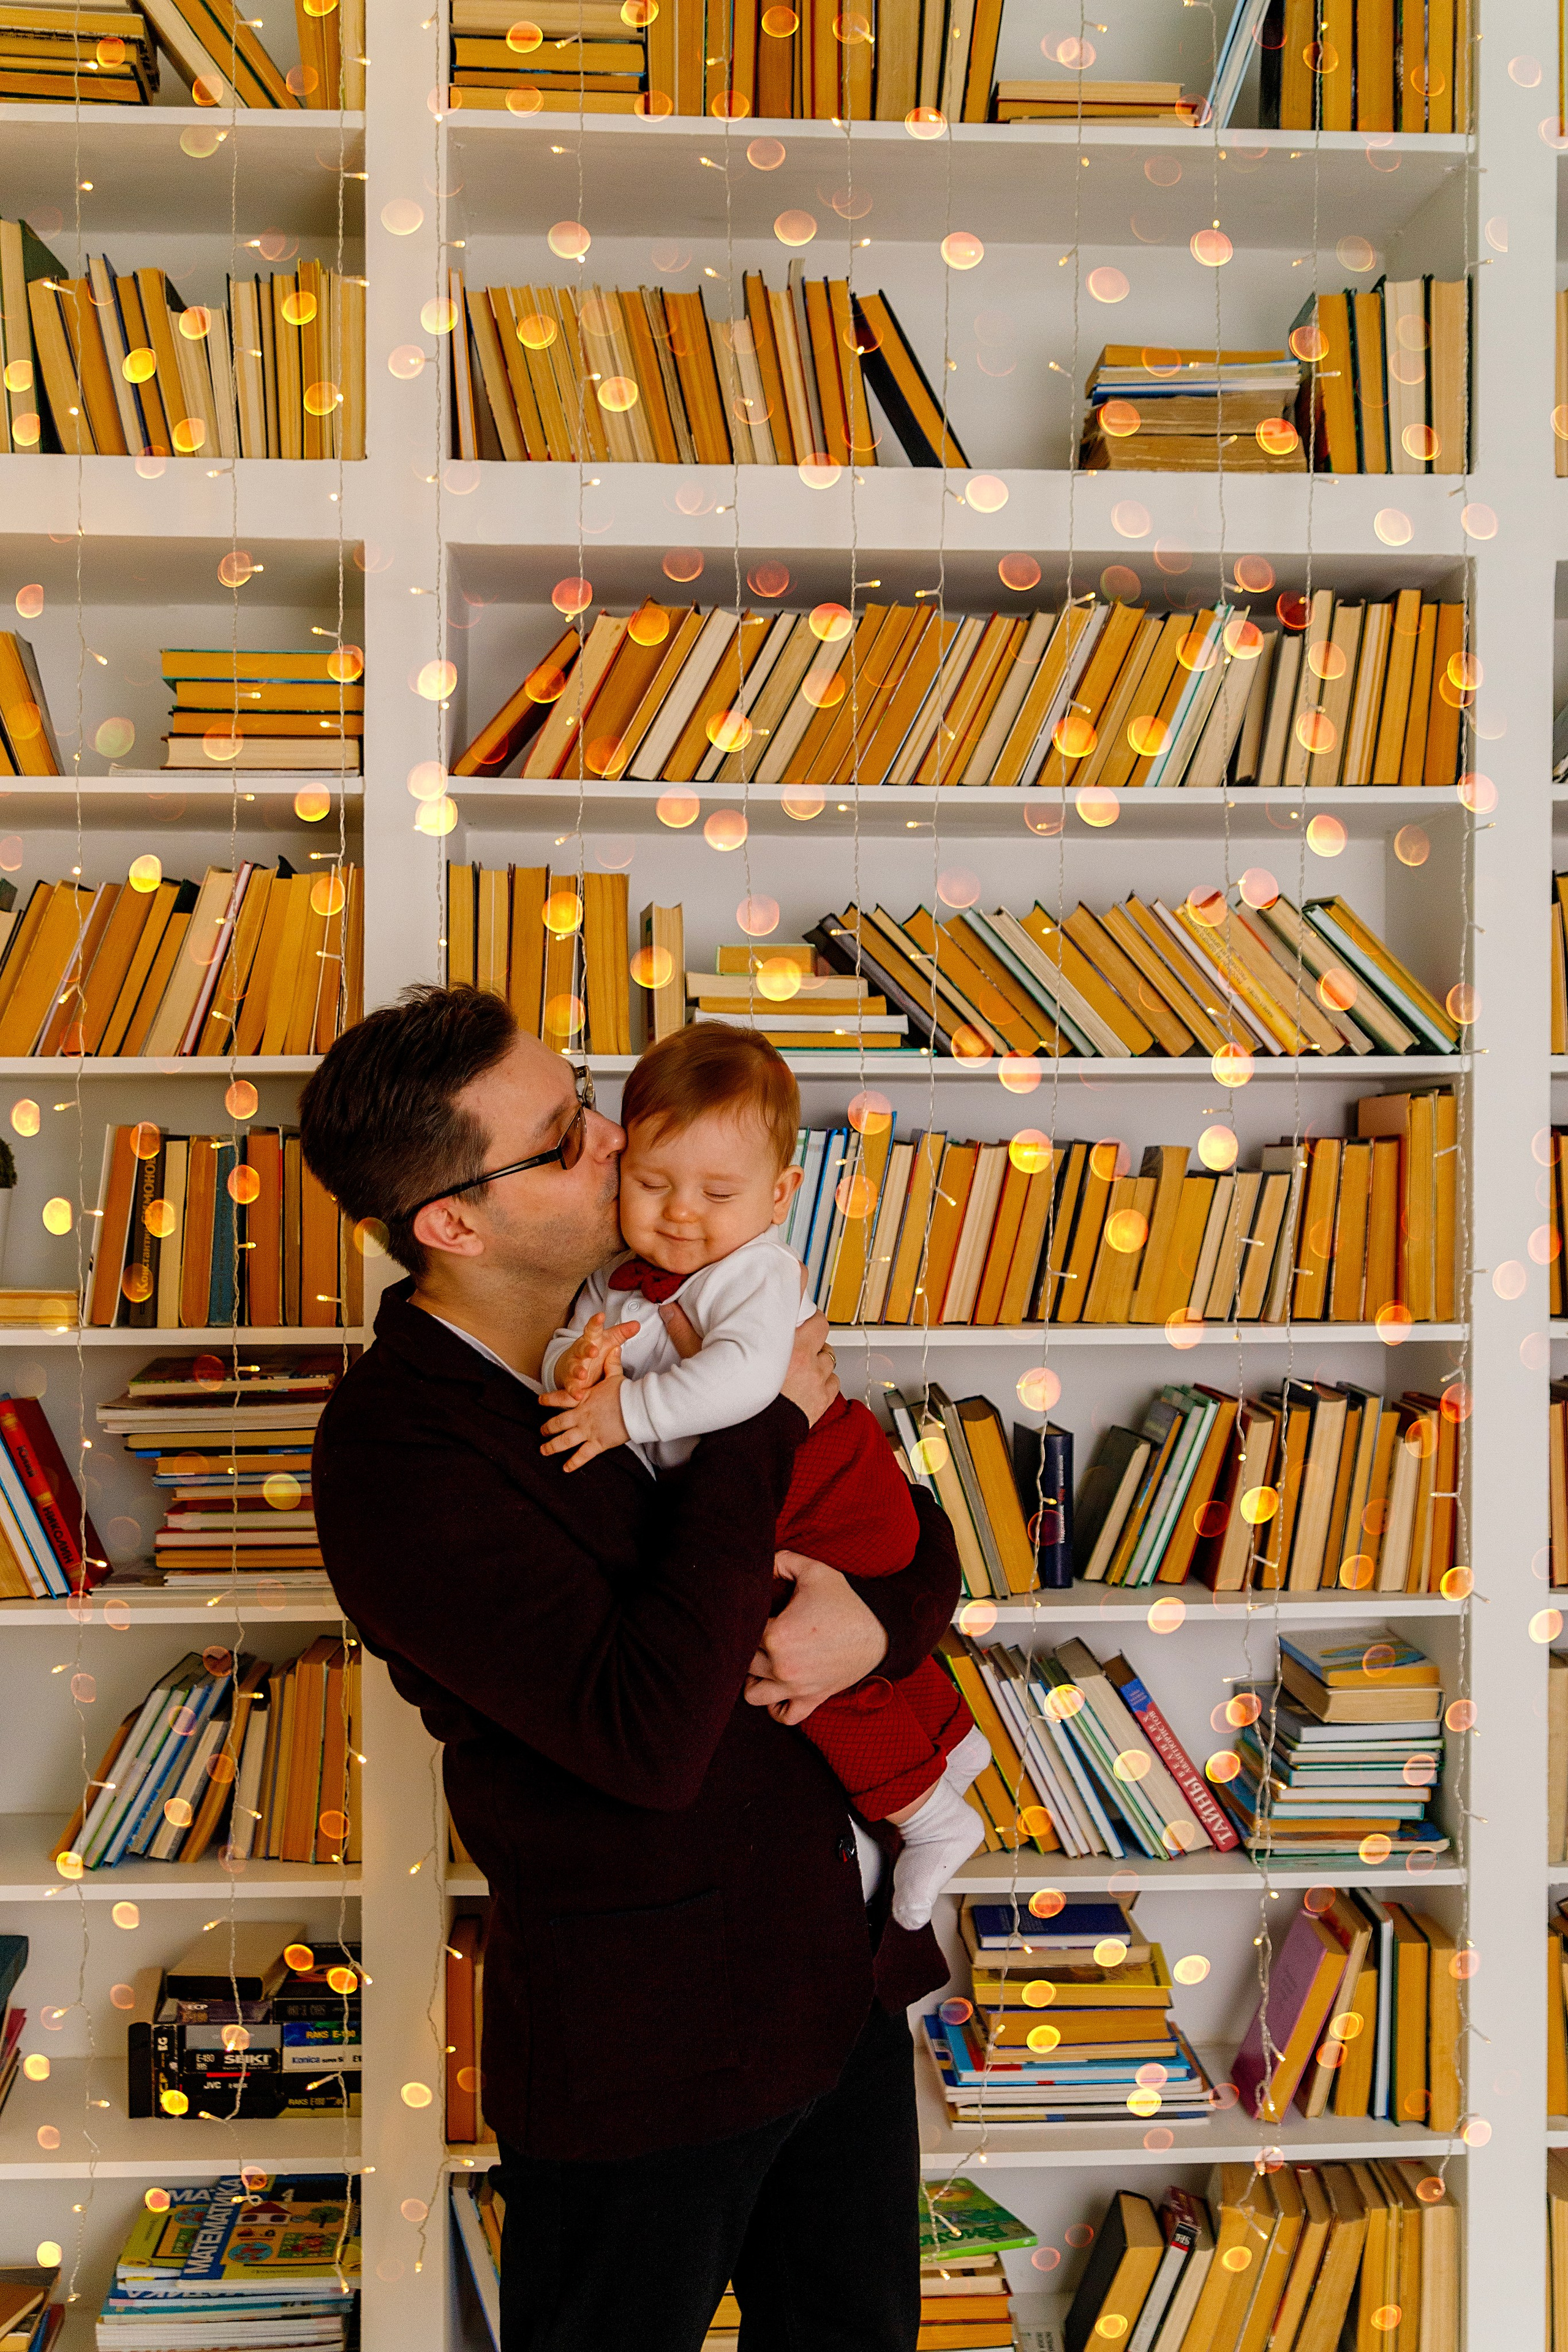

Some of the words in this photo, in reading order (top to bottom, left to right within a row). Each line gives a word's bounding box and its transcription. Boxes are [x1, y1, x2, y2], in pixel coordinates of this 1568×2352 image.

[43, 1506, 74, 1564] НИКОЛИН
[1143, 1714, 1183, 1778] ВЕЛИКИХ
[1148, 1710, 1192, 1774] АВАНТЮРИСТОВ
[1183, 1775, 1232, 1845] ТАЙНЫ
[184, 2179, 243, 2274] МАТЕМАТИКА
